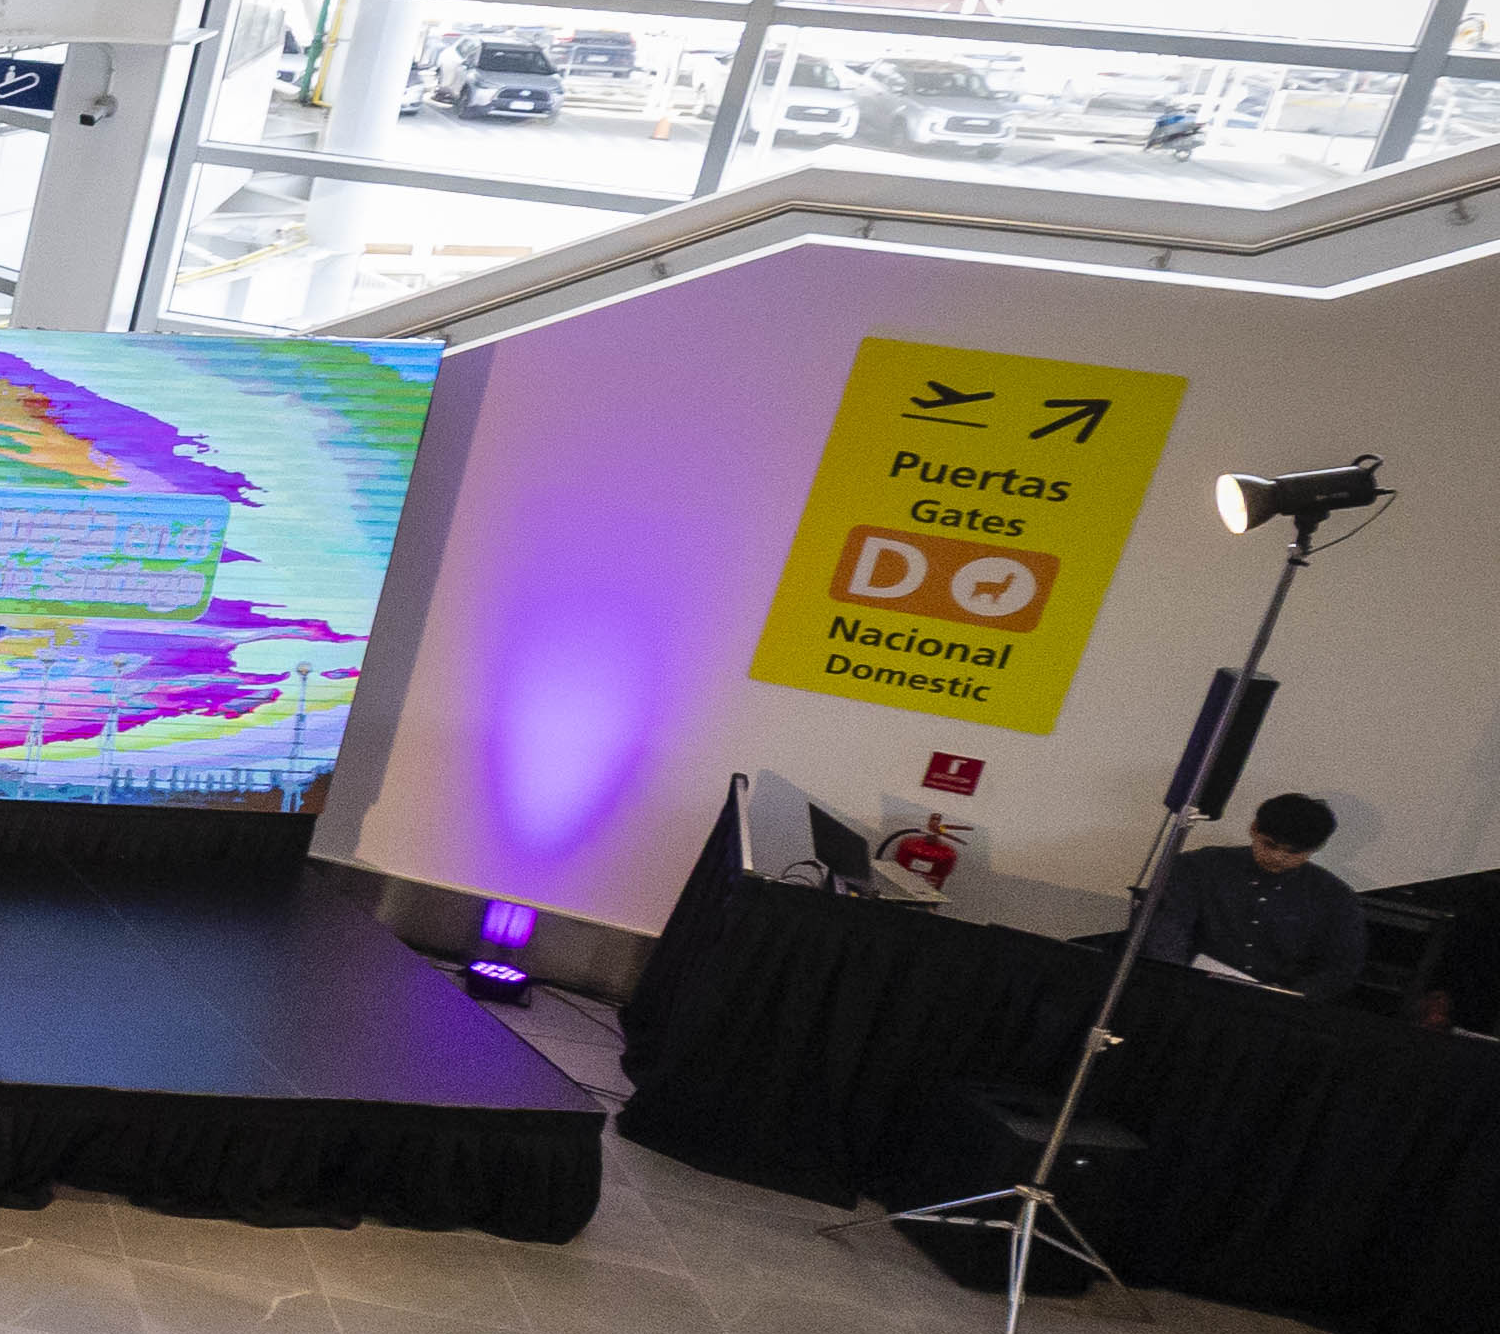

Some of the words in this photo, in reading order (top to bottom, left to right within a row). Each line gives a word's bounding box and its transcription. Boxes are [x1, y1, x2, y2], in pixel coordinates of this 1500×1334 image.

[889, 450, 1072, 502] Puertas
[910, 499, 1026, 537] Gates
[848, 536, 927, 599] D
[828, 616, 1012, 669] Nacional
[825, 653, 990, 703] Domestic
